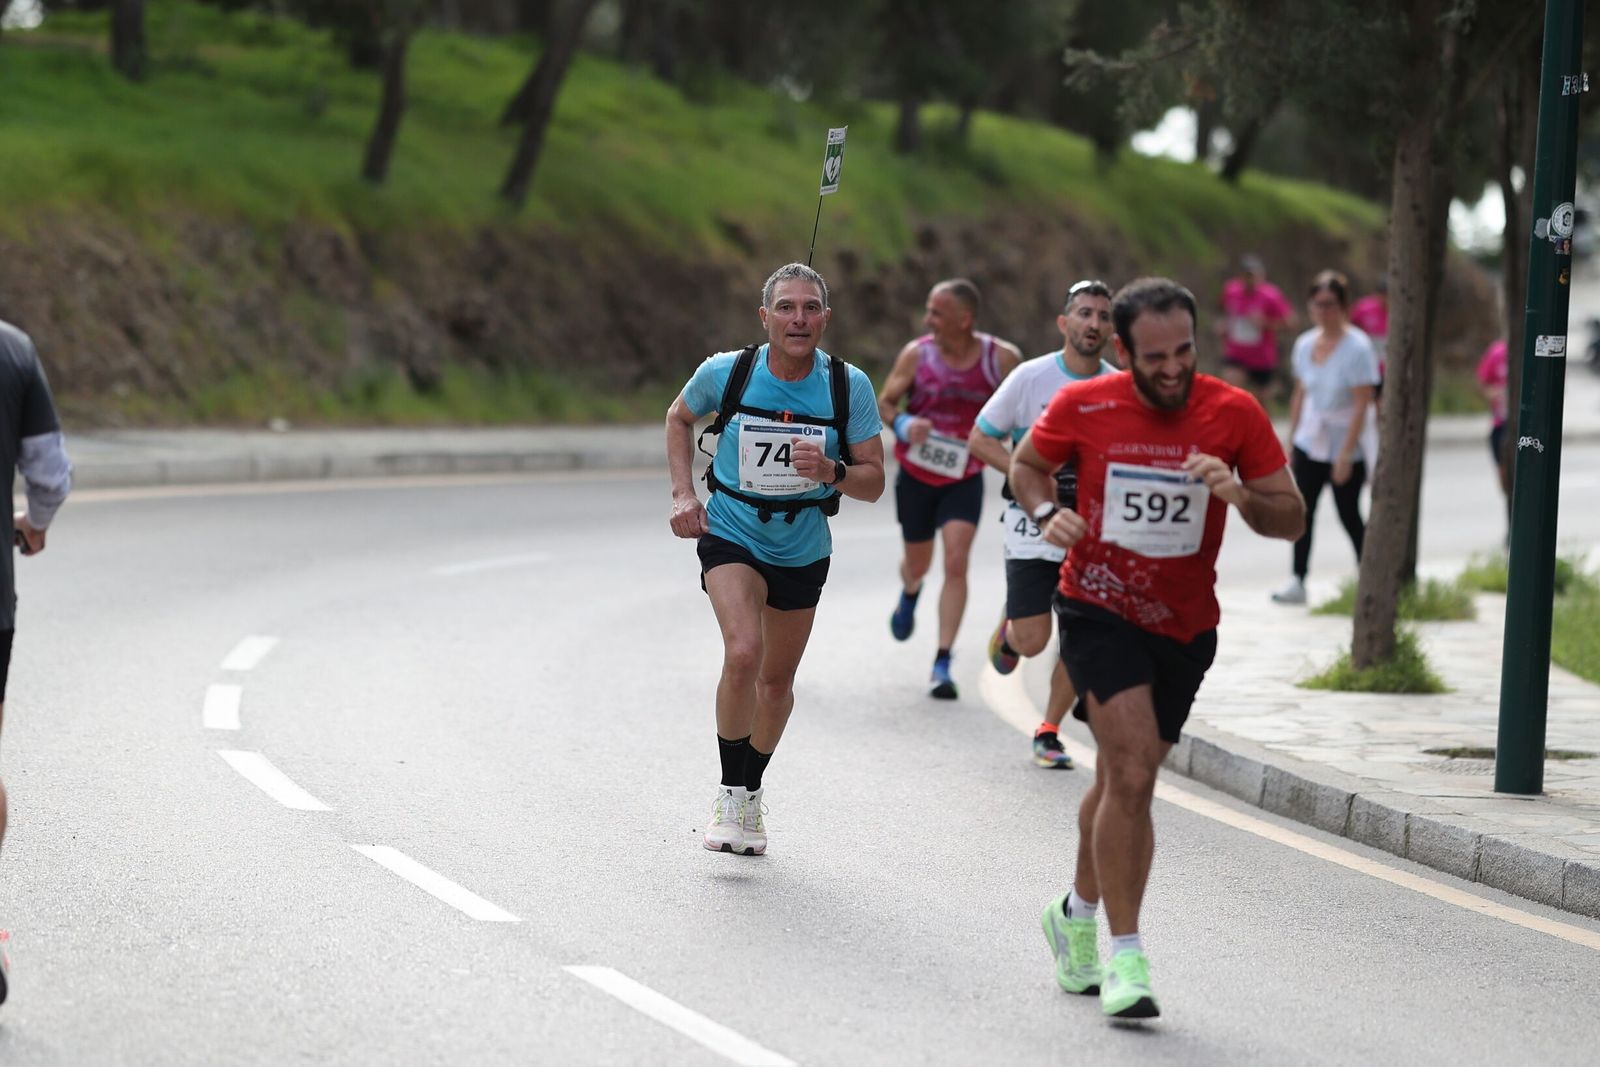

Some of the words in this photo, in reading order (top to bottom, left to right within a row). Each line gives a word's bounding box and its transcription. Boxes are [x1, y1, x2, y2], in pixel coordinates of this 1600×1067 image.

[755, 442, 793, 467] 74
[919, 444, 958, 469] 688
[1123, 492, 1191, 522] 592
[1014, 517, 1041, 537] 43
